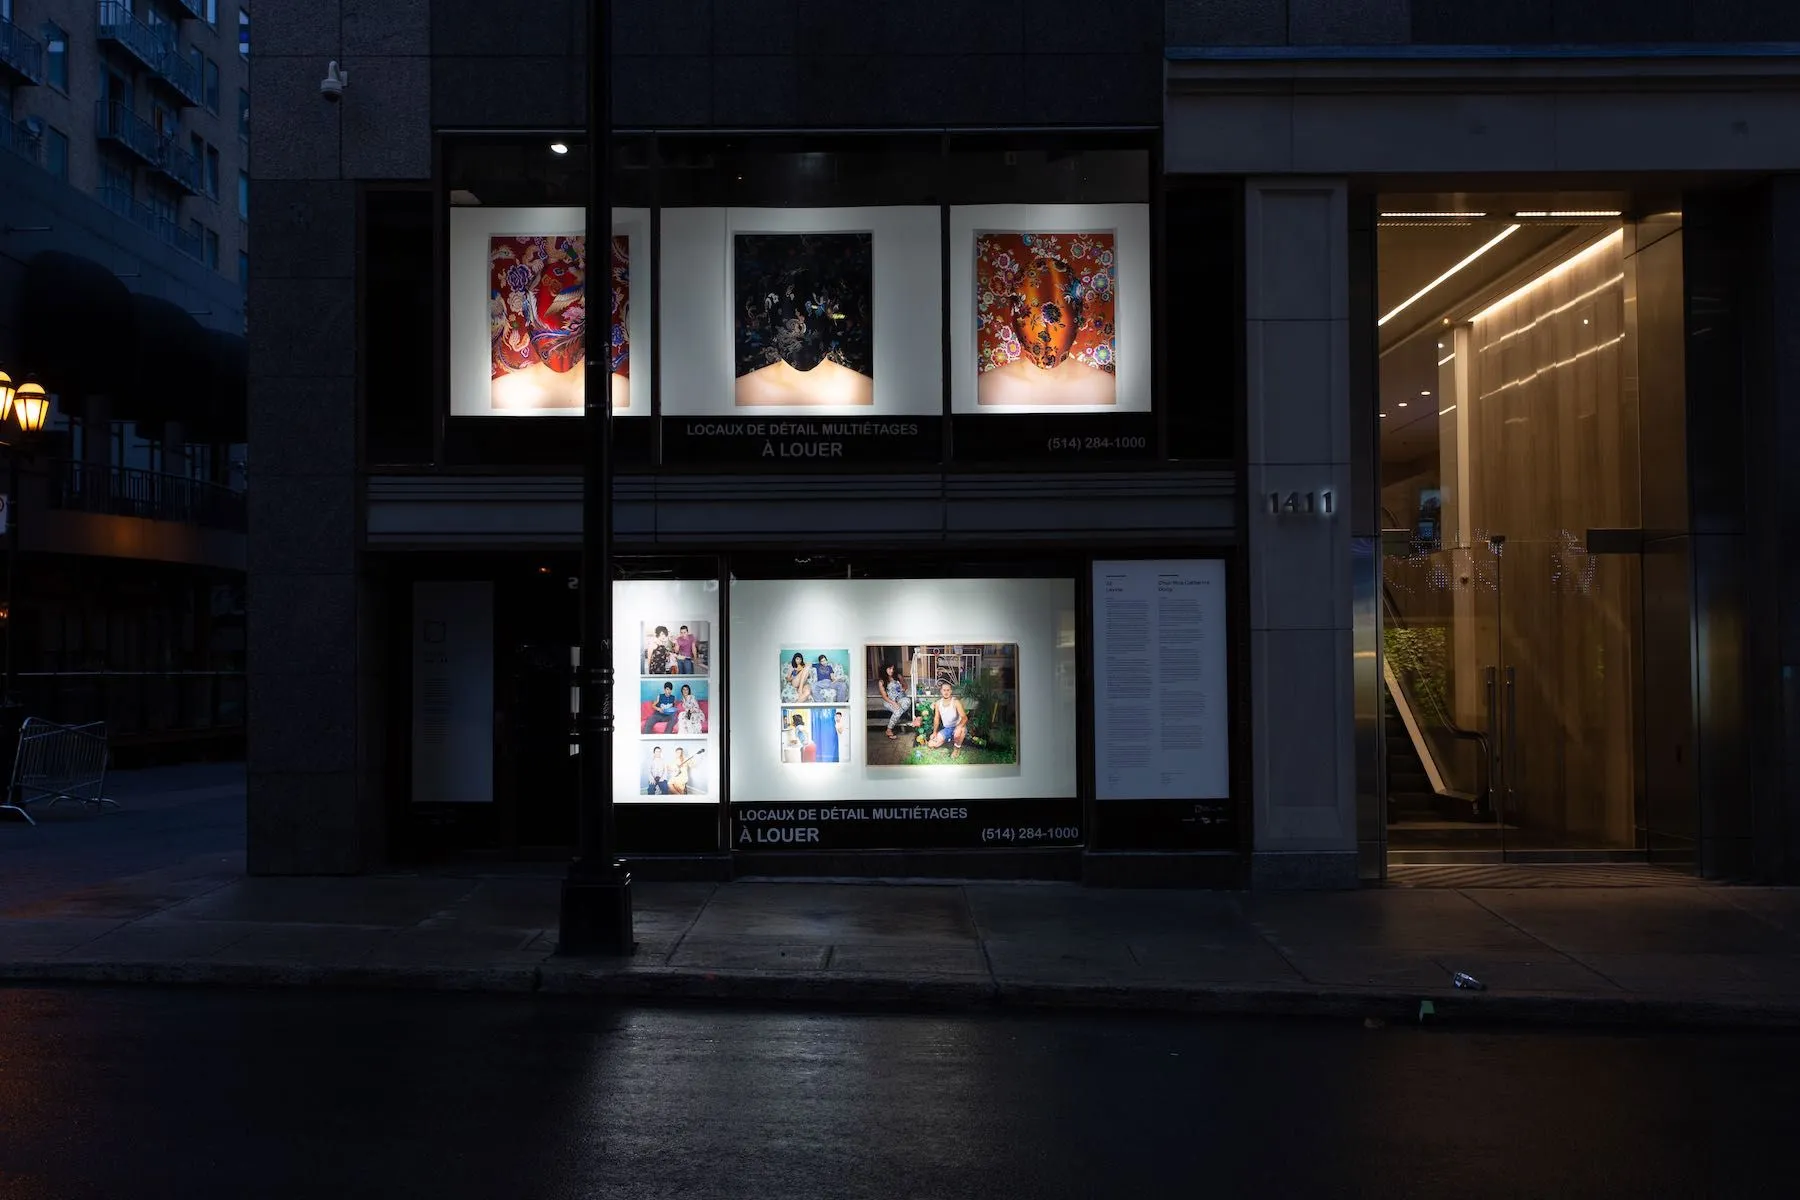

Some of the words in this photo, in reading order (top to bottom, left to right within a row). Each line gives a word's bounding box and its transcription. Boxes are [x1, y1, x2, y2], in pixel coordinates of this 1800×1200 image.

[686, 423, 744, 436] LOCAUX
[747, 423, 766, 436] DE
[769, 421, 818, 436] DÉTAIL
[822, 420, 919, 436] MULTIÉTAGES
[762, 439, 775, 457] À
[779, 441, 843, 457] LOUER
[1047, 437, 1081, 452] (514)
[1085, 436, 1146, 448] 284-1000
[1269, 491, 1333, 513] 1411
[739, 808, 795, 821] LOCAUX
[799, 808, 818, 821] DE
[820, 805, 870, 820] DÉTAIL
[872, 804, 969, 820] MULTIÉTAGES
[739, 825, 752, 843] À
[757, 827, 820, 843] LOUER
[981, 828, 1015, 842] (514)
[1018, 827, 1079, 839] 284-1000
